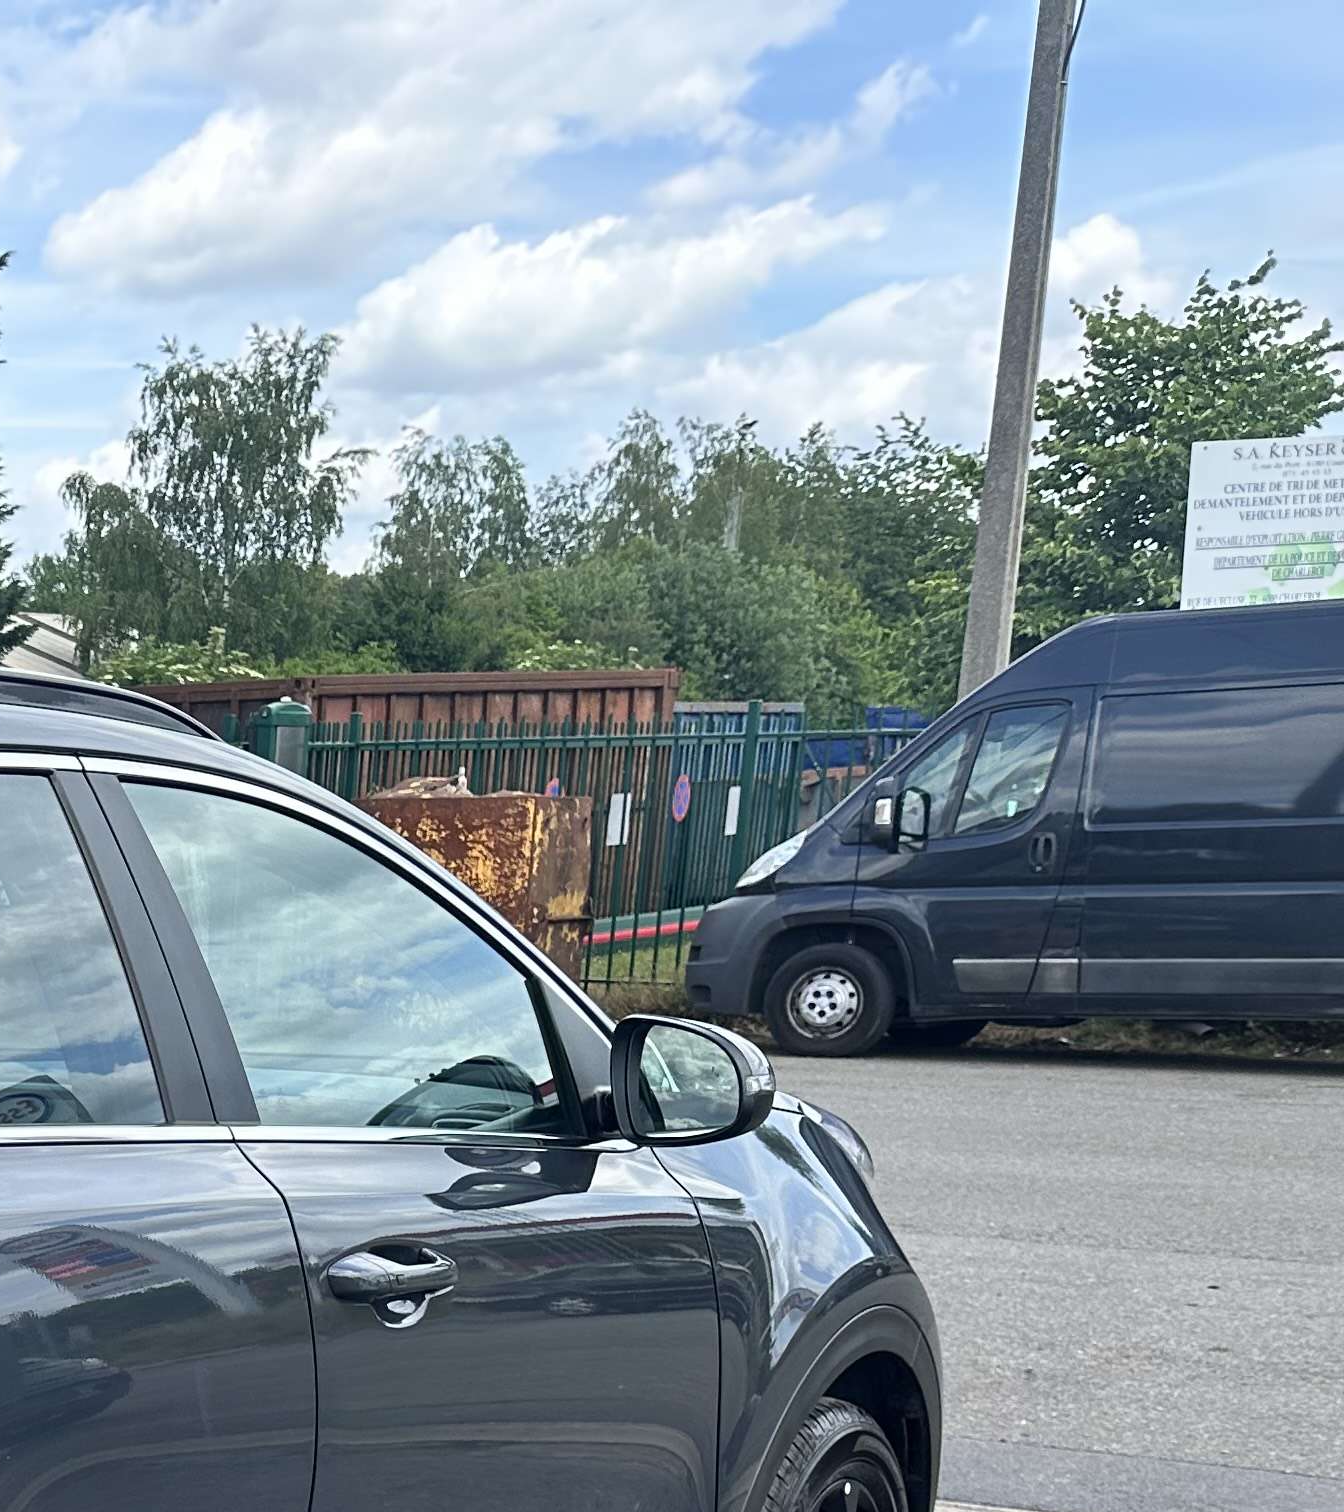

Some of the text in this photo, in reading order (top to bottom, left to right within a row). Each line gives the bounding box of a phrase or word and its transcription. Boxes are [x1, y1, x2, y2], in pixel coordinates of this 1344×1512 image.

[1269, 443, 1336, 459] KEYSER
[1223, 482, 1266, 494] CENTRE
[1268, 482, 1283, 492] DE
[1286, 480, 1304, 491] TRI
[1306, 479, 1319, 490] DE
[1193, 495, 1290, 510] DEMANTELEMENT
[1292, 494, 1306, 505] ET
[1308, 493, 1322, 504] DE
[1294, 507, 1323, 519] HORS
